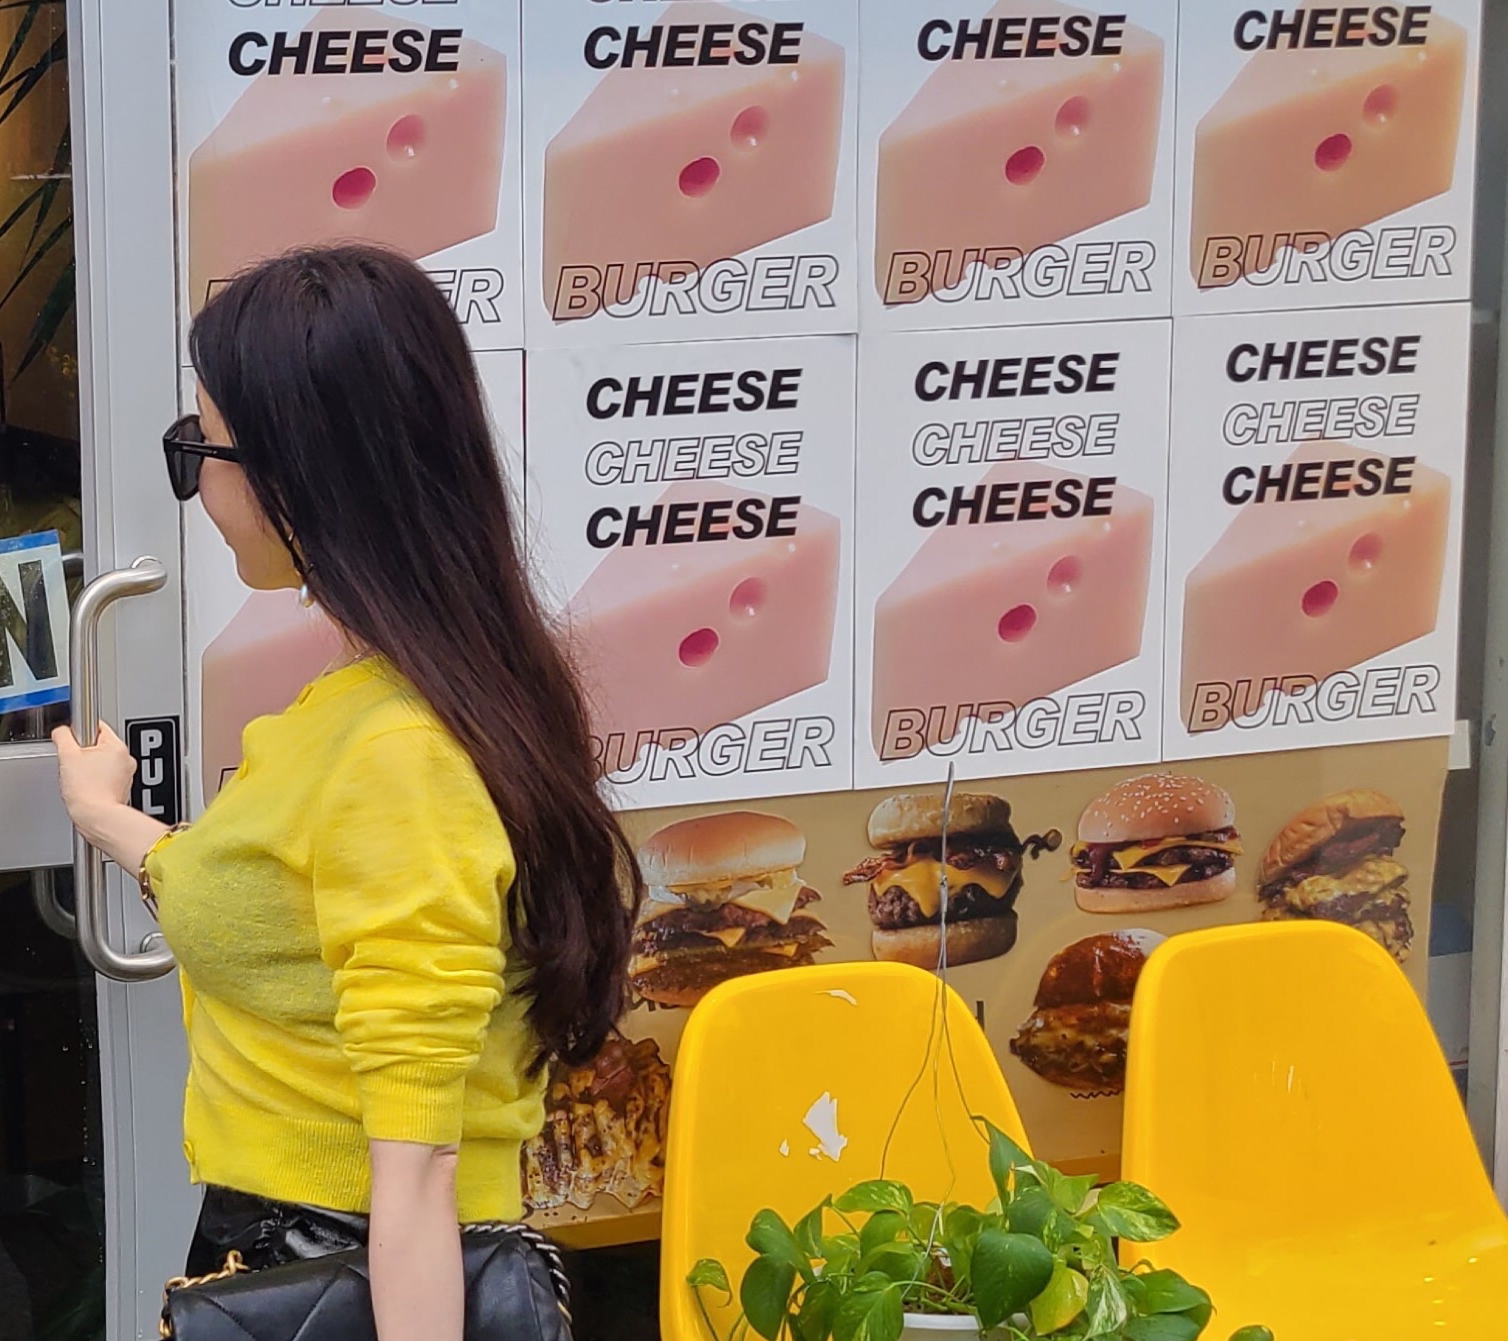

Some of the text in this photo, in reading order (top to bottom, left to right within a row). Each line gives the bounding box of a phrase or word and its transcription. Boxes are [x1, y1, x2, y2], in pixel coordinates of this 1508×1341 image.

[228, 29, 463, 76] CHEESE
[583, 22, 804, 70] CHEESE
[917, 14, 1127, 61] CHEESE
[1233, 5, 1432, 52] CHEESE
[883, 241, 1156, 306] BURGER
[1198, 225, 1457, 289] BURGER
[551, 255, 839, 321] BURGER
[914, 352, 1120, 402] CHEESE
[1226, 335, 1421, 383] CHEESE
[586, 368, 803, 420] CHEESE
[1222, 394, 1420, 446] CHEESE
[585, 431, 804, 486] CHEESE
[912, 413, 1120, 467] CHEESE
[912, 476, 1117, 528] CHEESE
[1222, 456, 1417, 506] CHEESE
[586, 495, 802, 549] CHEESE
[1187, 664, 1441, 733] BURGER
[879, 690, 1146, 761] BURGER
